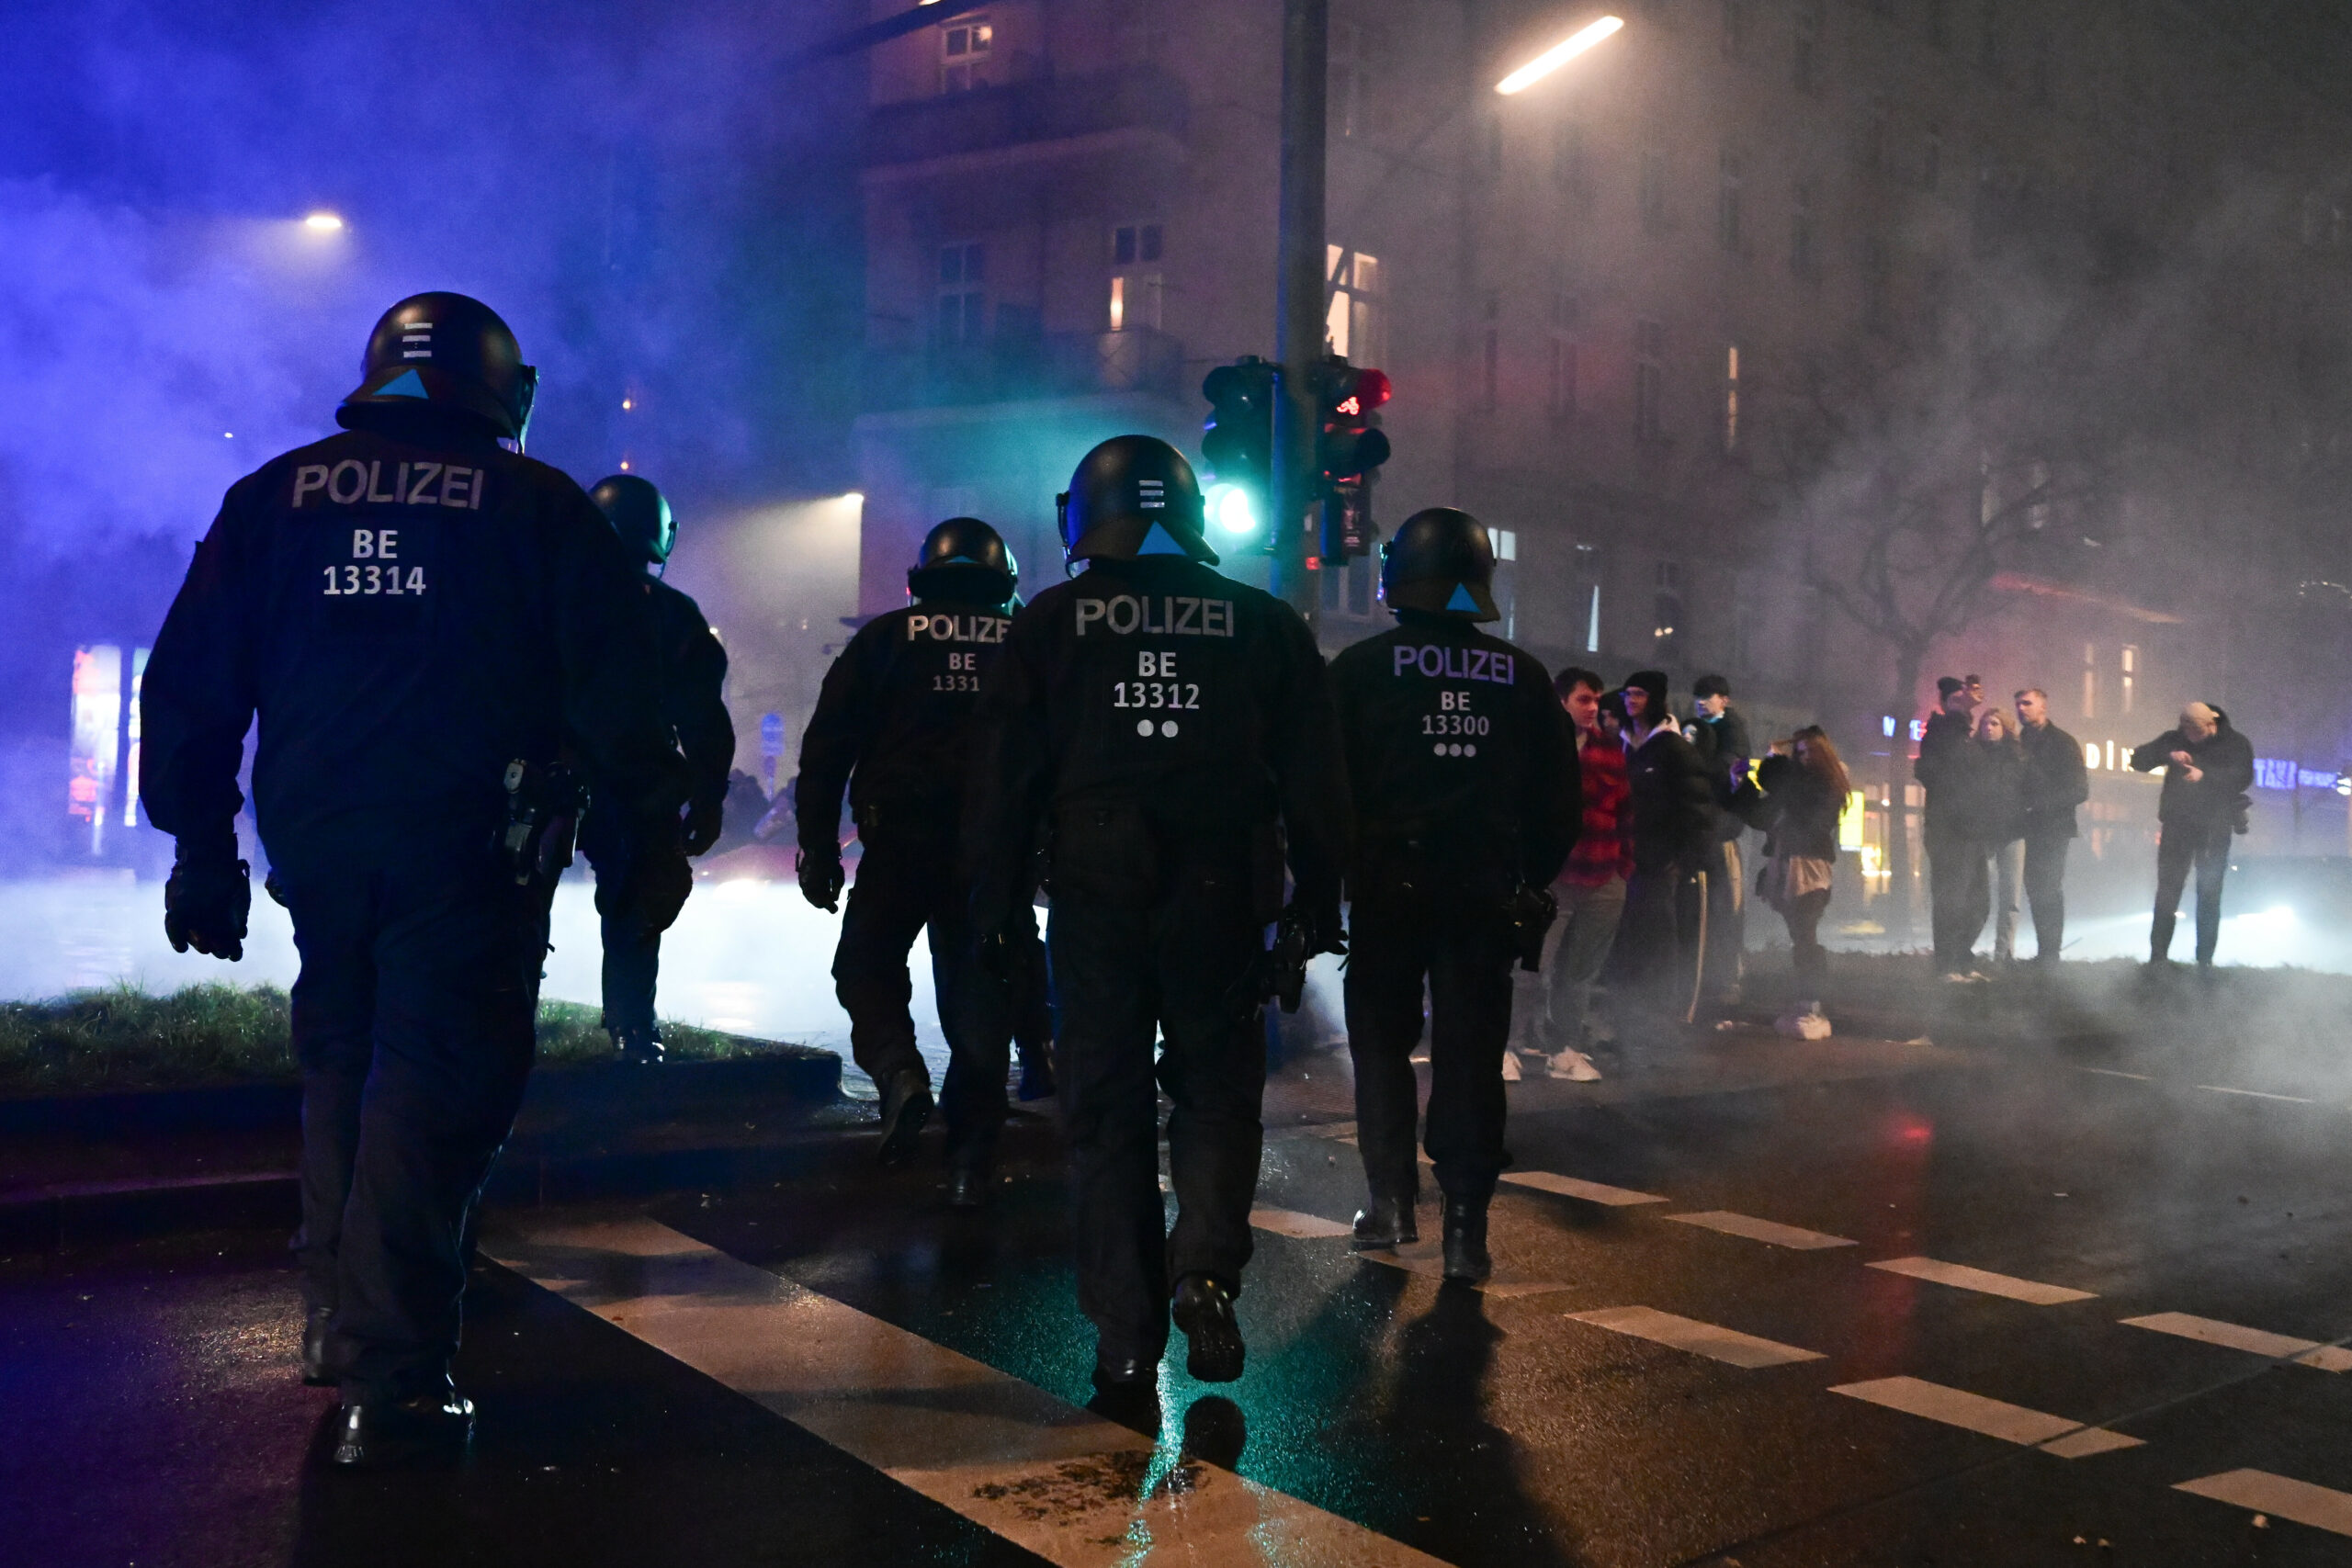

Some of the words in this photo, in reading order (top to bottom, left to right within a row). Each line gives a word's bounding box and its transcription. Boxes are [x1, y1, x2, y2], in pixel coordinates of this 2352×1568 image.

[291, 458, 484, 510] POLIZEI
[352, 528, 398, 558] BE
[322, 565, 426, 595] 13314
[907, 614, 1012, 644] POLIZE
[1075, 594, 1235, 637] POLIZEI
[948, 652, 977, 671] BE
[1138, 650, 1177, 677] BE
[1393, 644, 1514, 685] POLIZEI
[933, 674, 980, 692] 1331
[1114, 682, 1200, 710] 13312
[1441, 691, 1471, 711] BE
[1422, 715, 1489, 736] 13300
